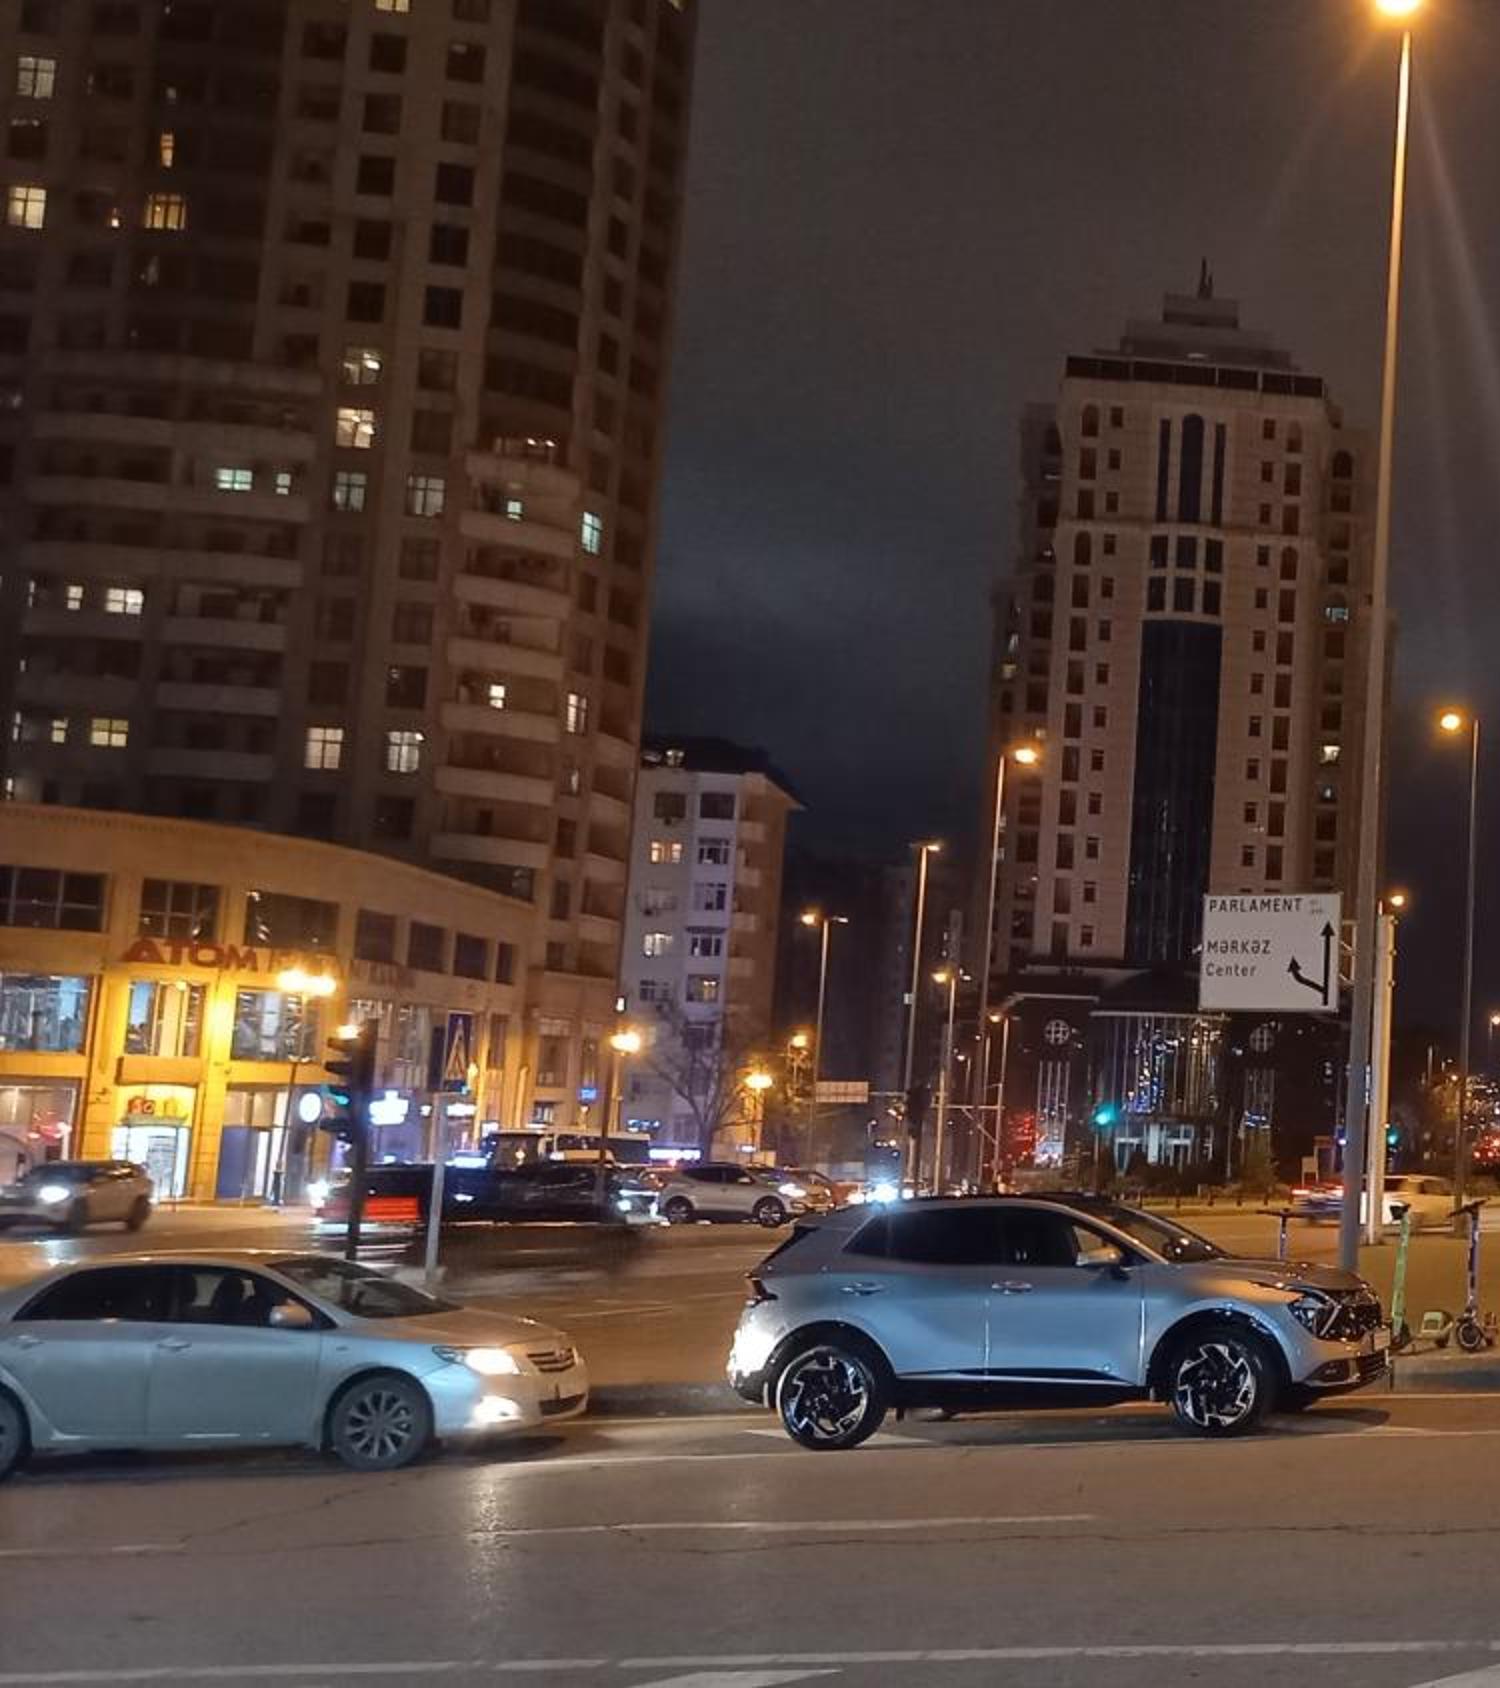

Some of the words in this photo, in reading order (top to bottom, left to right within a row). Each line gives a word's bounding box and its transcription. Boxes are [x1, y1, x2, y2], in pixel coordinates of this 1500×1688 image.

[1208, 898, 1302, 913] PARLAMENT
[121, 938, 257, 971] ATOM
[1205, 962, 1257, 977] Center
